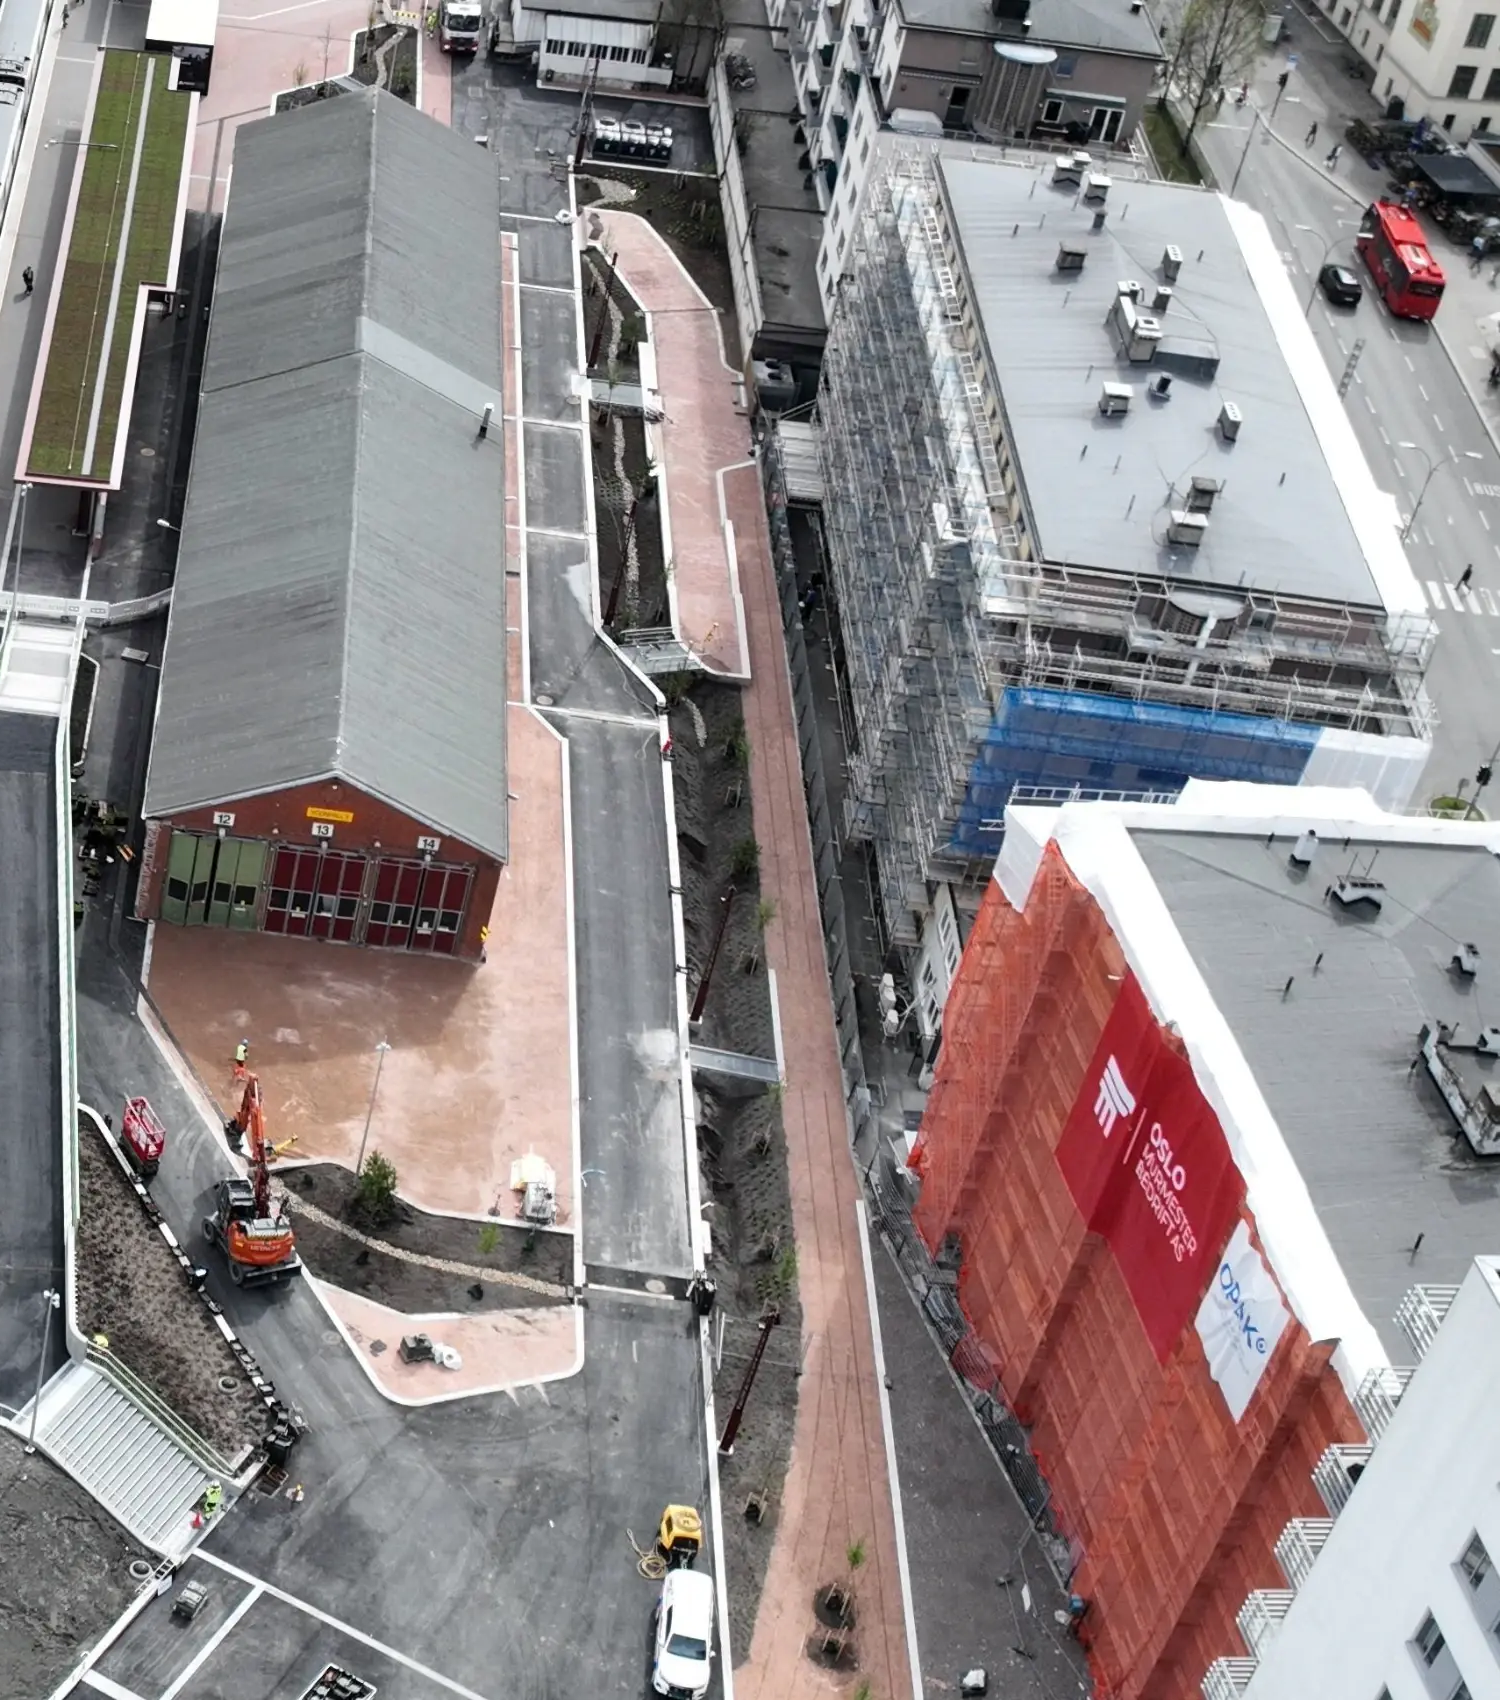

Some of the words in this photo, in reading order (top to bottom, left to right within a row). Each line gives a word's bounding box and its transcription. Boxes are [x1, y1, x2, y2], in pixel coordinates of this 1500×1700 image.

[217, 814, 231, 825] 12
[316, 824, 330, 836] 13
[422, 838, 436, 849] 14
[1150, 1121, 1186, 1191] OSLO
[1135, 1159, 1176, 1237] BEDRIFT
[1170, 1234, 1185, 1262] AS
[1142, 1142, 1197, 1257] MURMESTER
[1220, 1263, 1259, 1349] OPAK
